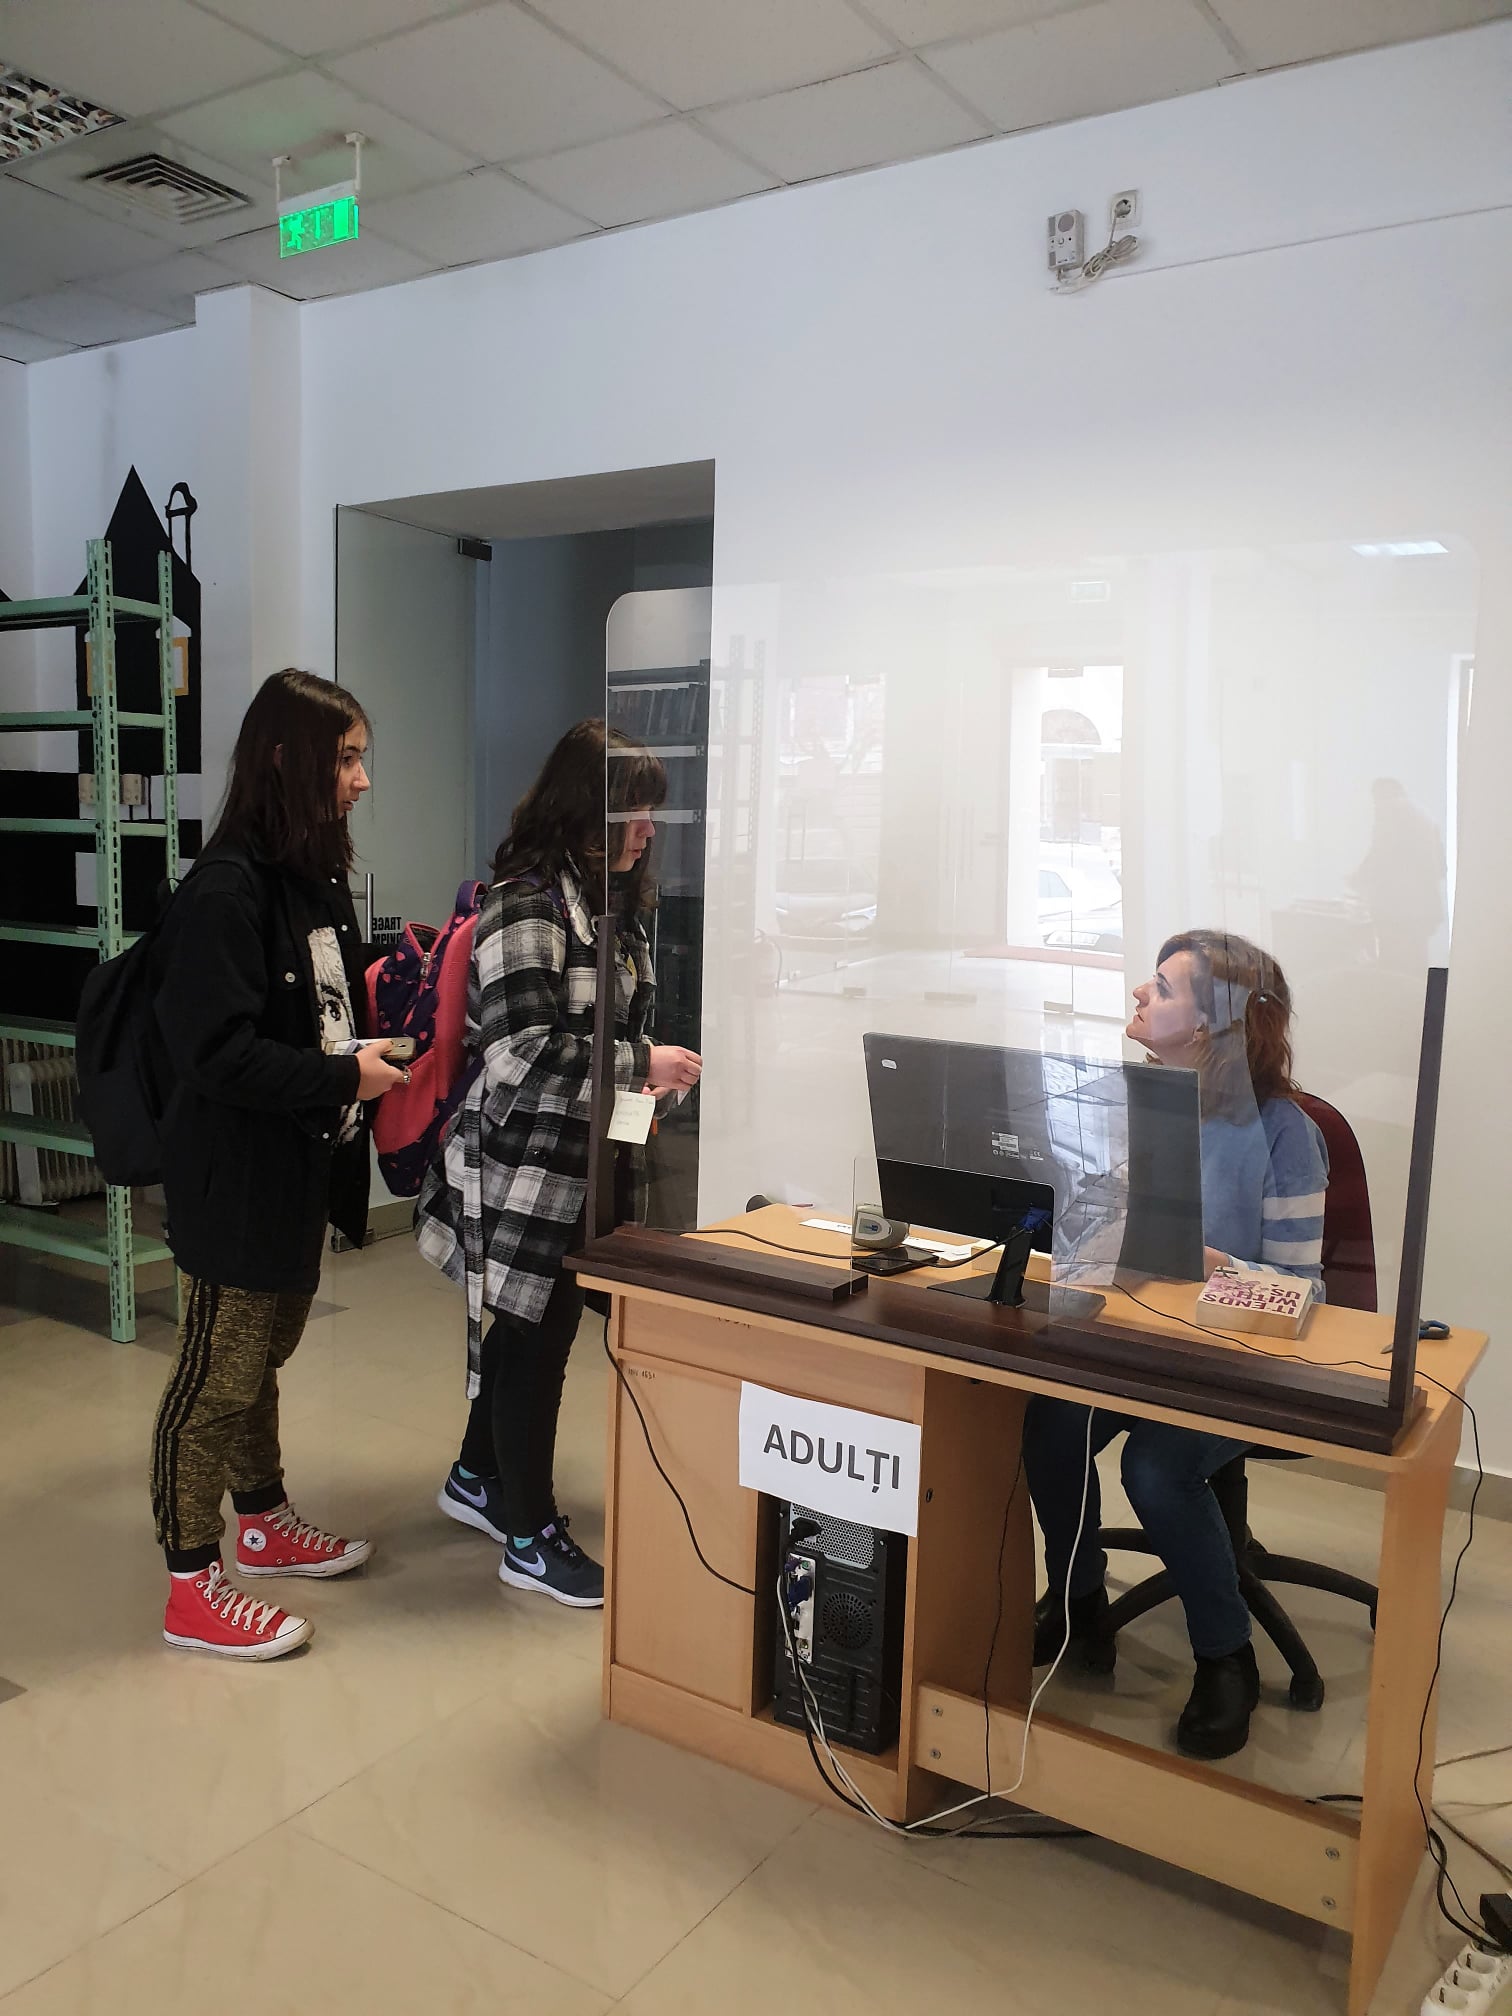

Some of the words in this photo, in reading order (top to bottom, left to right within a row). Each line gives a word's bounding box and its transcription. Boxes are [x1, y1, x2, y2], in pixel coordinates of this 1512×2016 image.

[1202, 1293, 1266, 1310] ENDS
[1236, 1290, 1297, 1308] WITH
[1270, 1288, 1301, 1300] US
[1272, 1304, 1295, 1315] IT
[763, 1423, 900, 1494] ADULȚI
